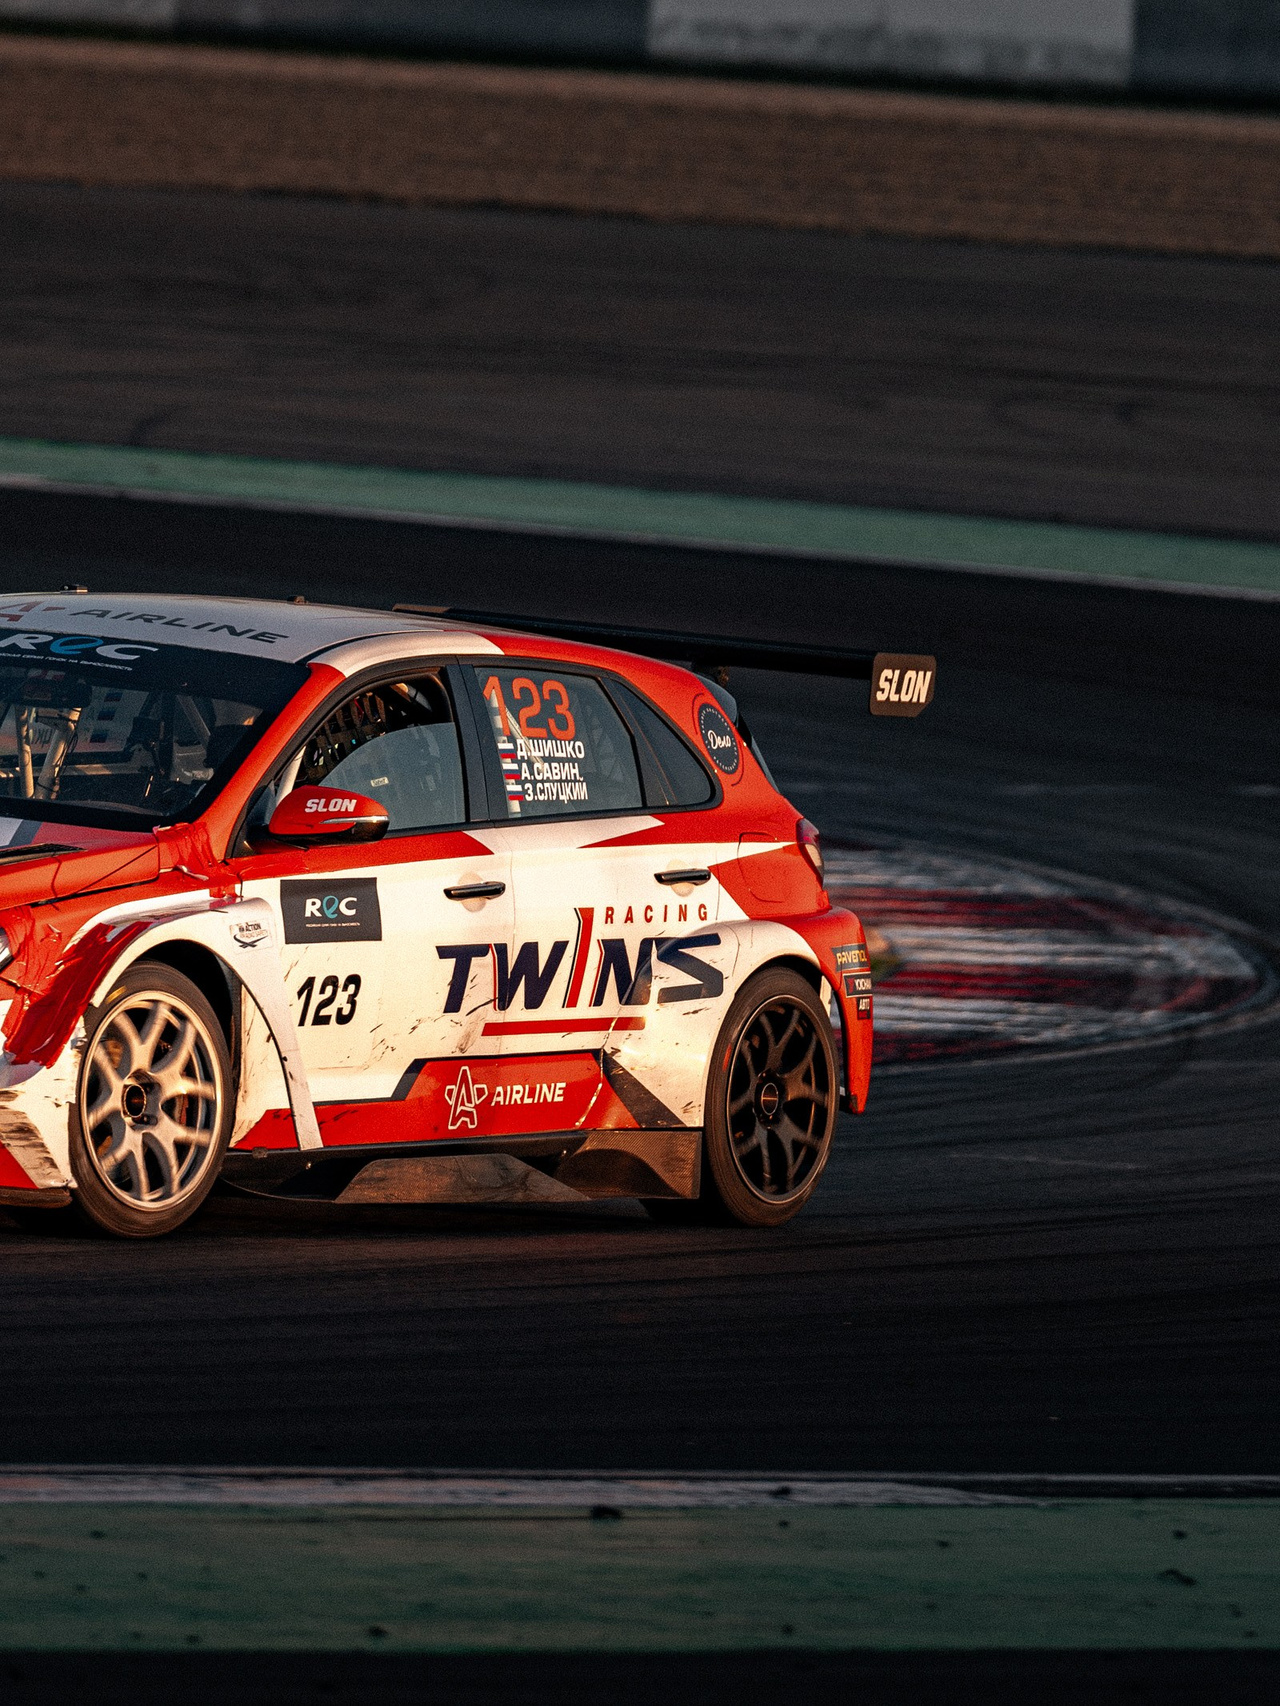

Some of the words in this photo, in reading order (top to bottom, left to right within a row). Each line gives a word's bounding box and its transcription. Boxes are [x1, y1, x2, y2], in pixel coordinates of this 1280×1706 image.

[70, 608, 290, 644] AIRLINE
[876, 668, 932, 703] SLON
[483, 675, 576, 740] 123
[516, 739, 585, 760] Д.ШИШКО
[521, 762, 580, 781] А.САВИН
[524, 777, 588, 804] З.СЛУЦКИЙ
[304, 798, 357, 813] SLON
[605, 903, 708, 924] RACING
[435, 907, 724, 1013] TWINS
[296, 973, 362, 1027] 123
[491, 1082, 567, 1107] AIRLINE
